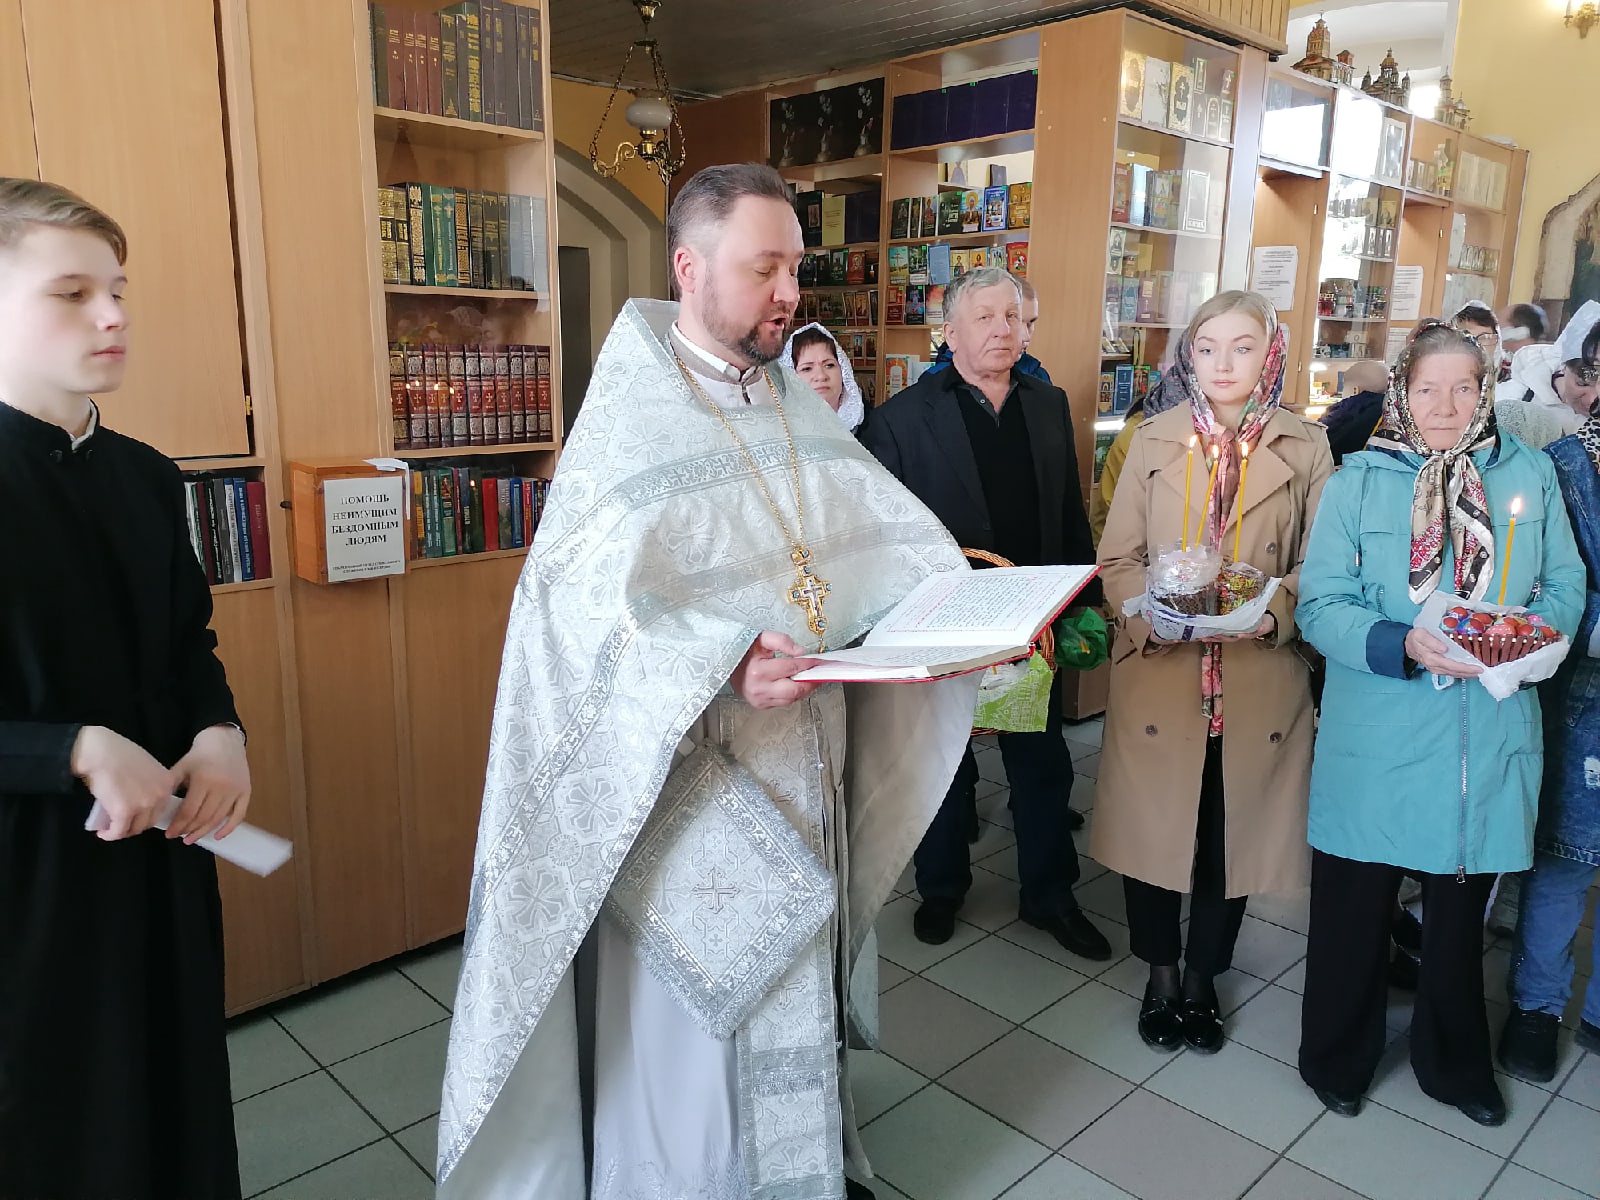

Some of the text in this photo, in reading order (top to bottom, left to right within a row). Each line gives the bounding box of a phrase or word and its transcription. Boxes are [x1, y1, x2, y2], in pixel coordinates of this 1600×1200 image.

[341, 494, 390, 505] ПОМОЩЬ
[333, 508, 397, 520] НЕИМУЩИМ
[332, 521, 399, 534] БЕЗДОМНЫМ
[345, 534, 387, 546] ЛЮДЯМ
